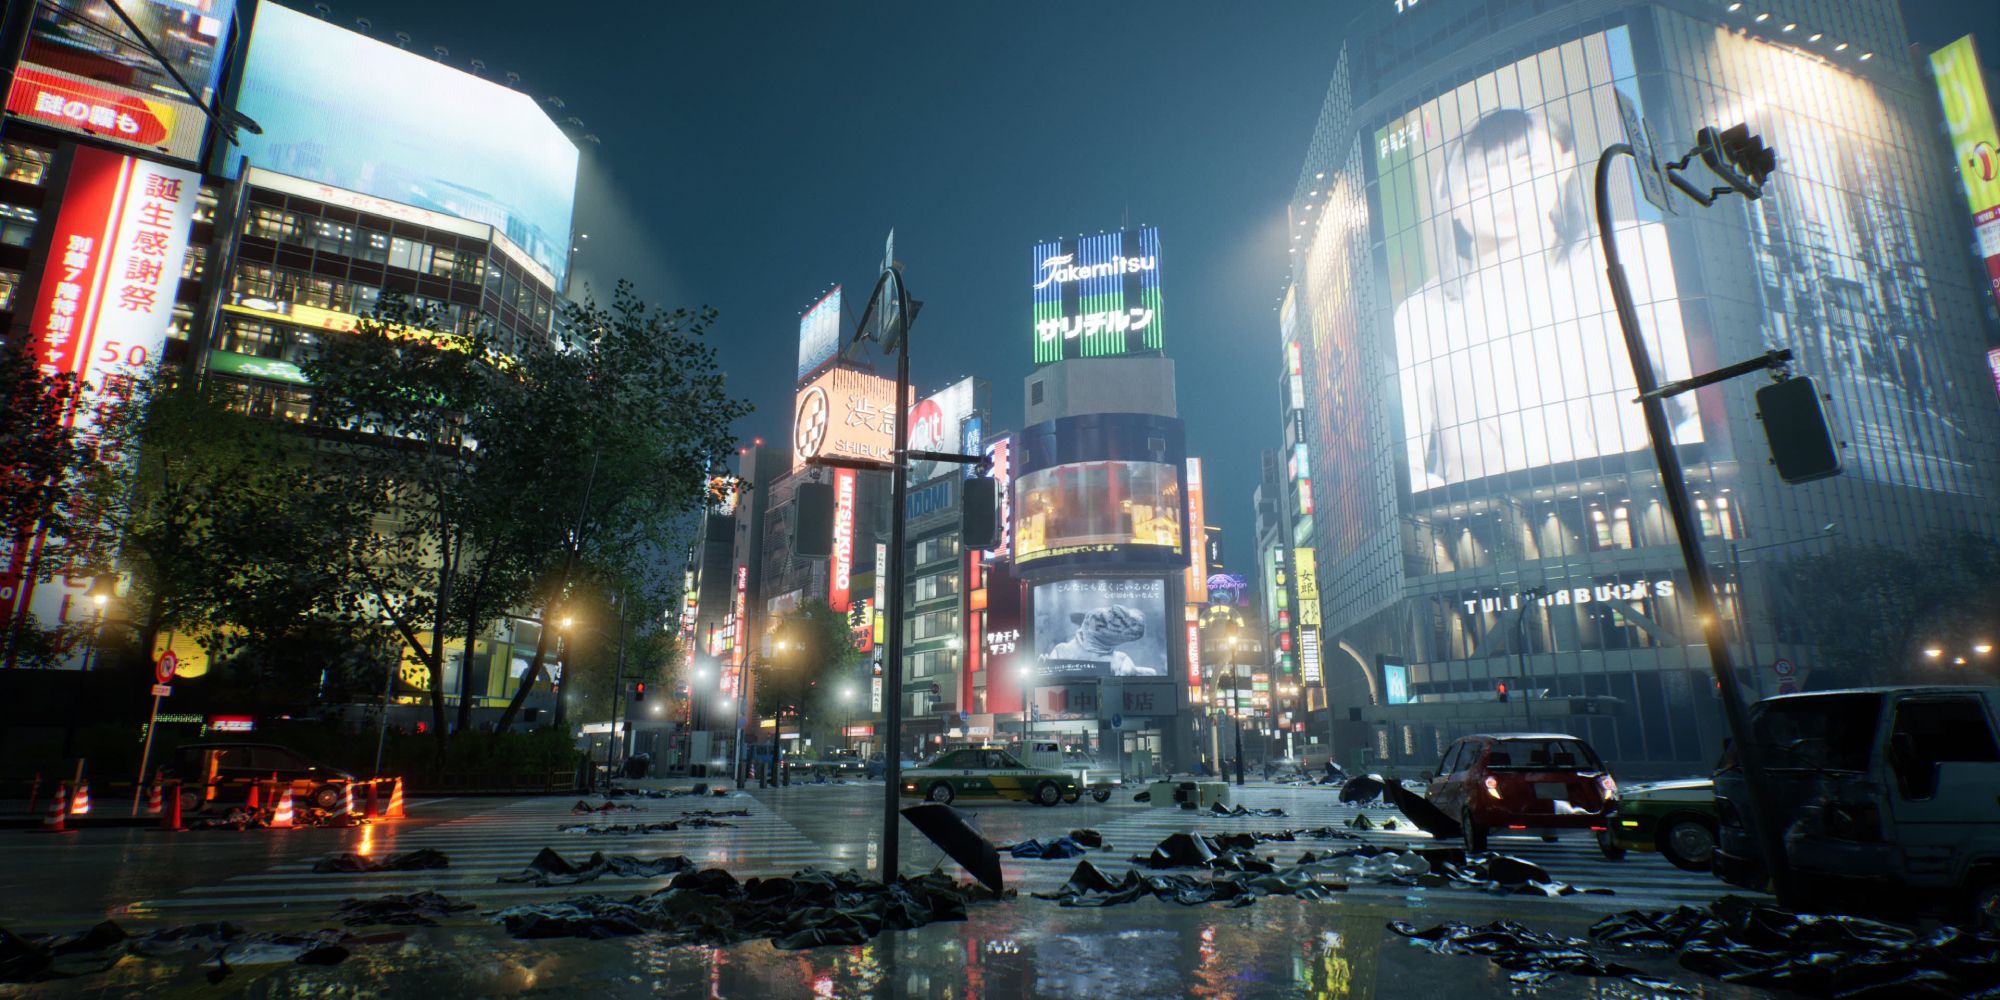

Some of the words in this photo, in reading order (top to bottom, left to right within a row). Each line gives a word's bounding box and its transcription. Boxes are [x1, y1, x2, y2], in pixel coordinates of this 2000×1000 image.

[119, 173, 182, 313] 誕生感謝祭
[834, 438, 893, 461] SHIBUK
